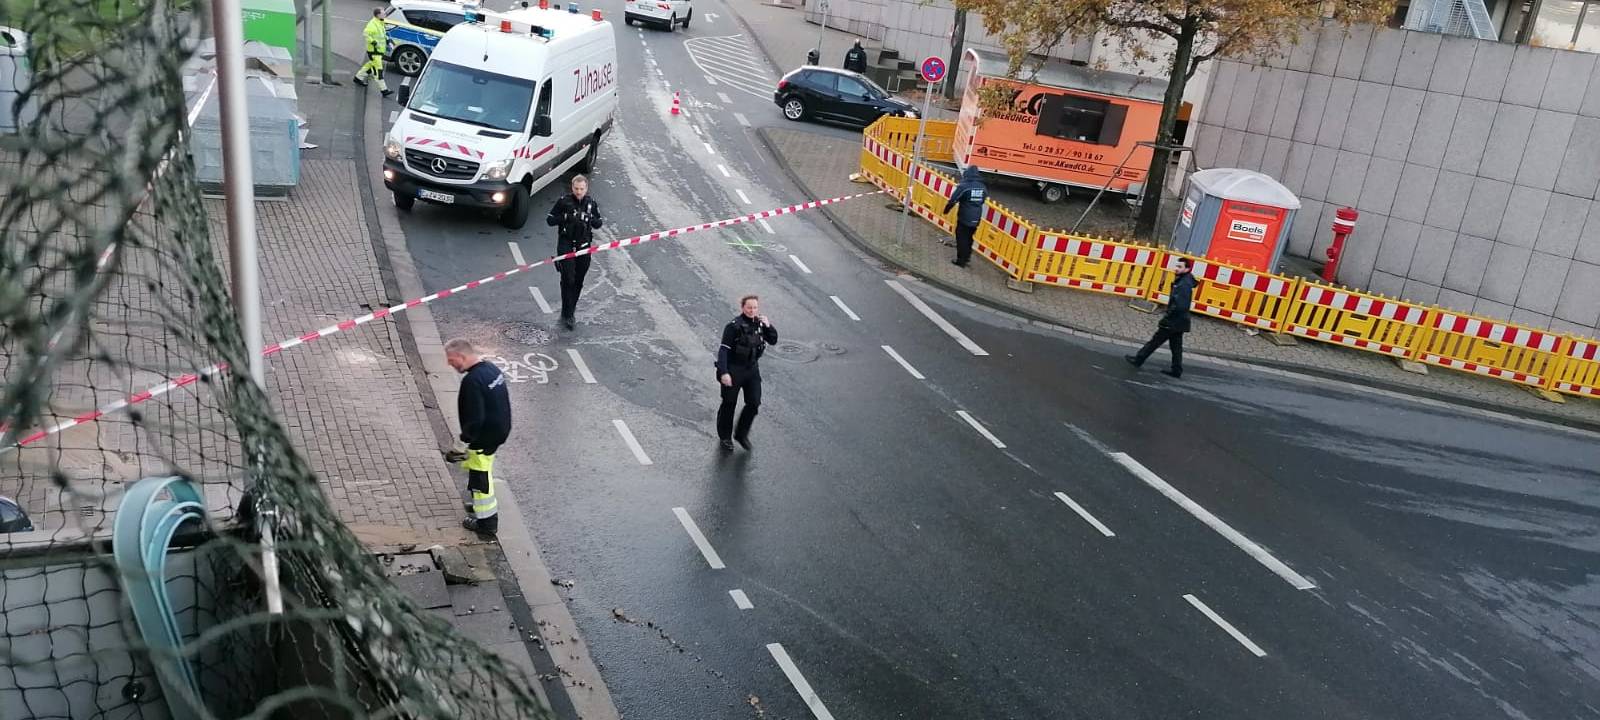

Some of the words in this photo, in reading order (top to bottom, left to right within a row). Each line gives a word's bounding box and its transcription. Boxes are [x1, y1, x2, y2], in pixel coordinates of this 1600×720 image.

[573, 62, 614, 103] Zuhause.
[1022, 142, 1036, 151] Tel.:
[1084, 152, 1093, 160] 18
[1094, 153, 1104, 161] 67
[1233, 223, 1264, 234] Boels
